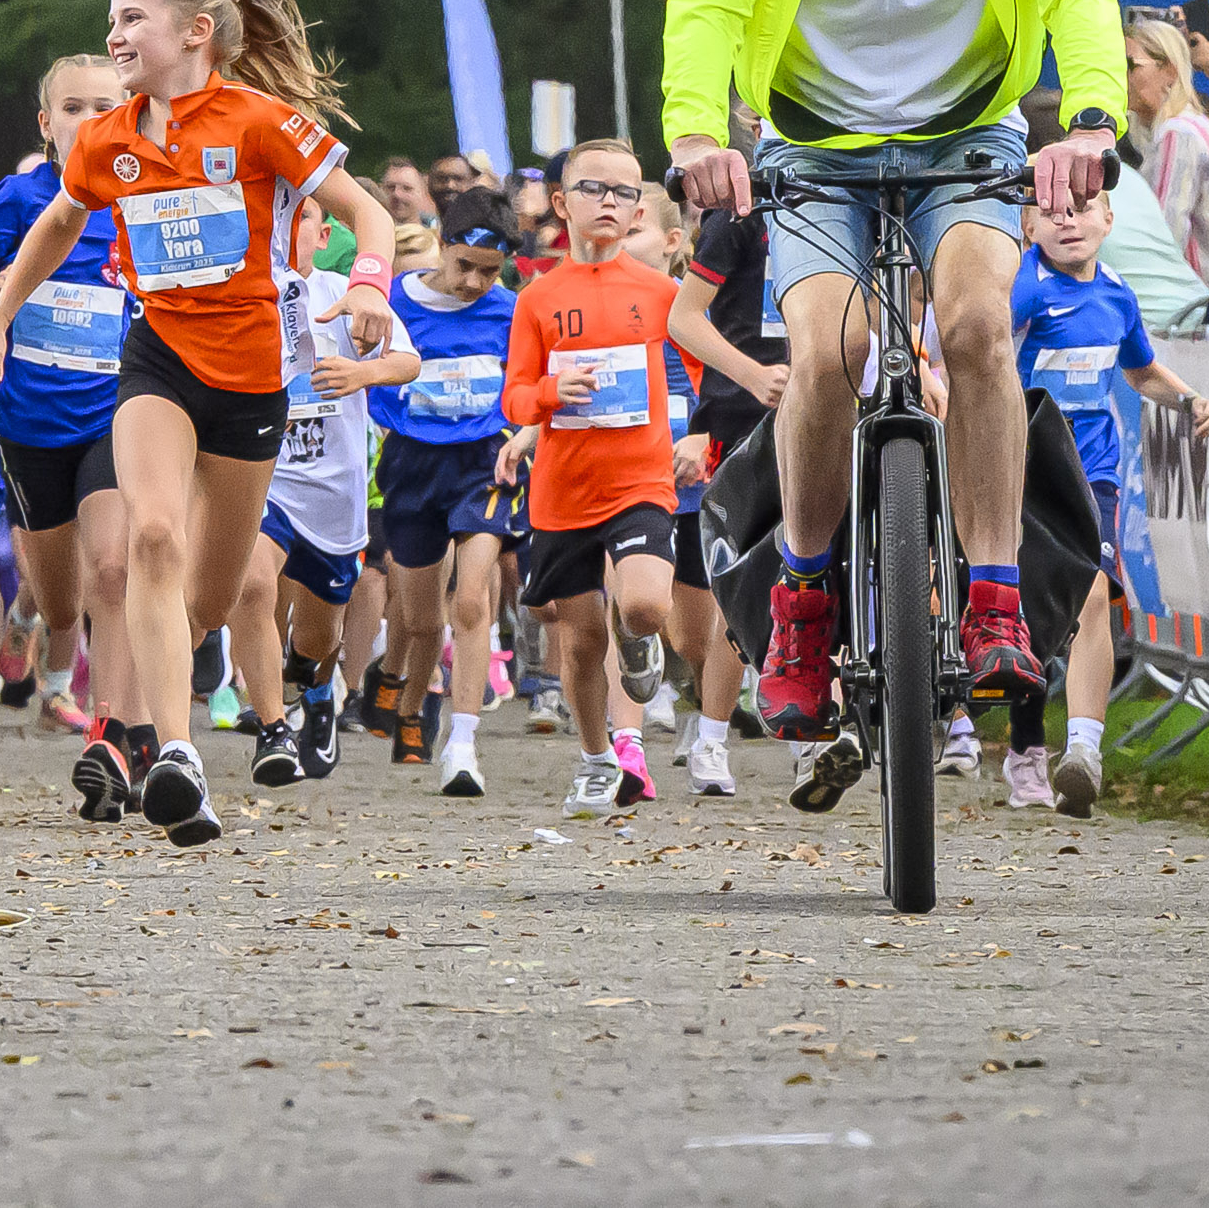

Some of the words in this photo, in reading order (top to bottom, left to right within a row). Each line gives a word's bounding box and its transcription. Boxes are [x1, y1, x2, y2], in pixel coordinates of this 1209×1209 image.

[153, 195, 180, 213] pure
[158, 207, 189, 220] energie
[160, 218, 200, 240] 9200
[162, 238, 204, 260] Yara
[52, 286, 80, 299] pure
[552, 309, 583, 339] 10
